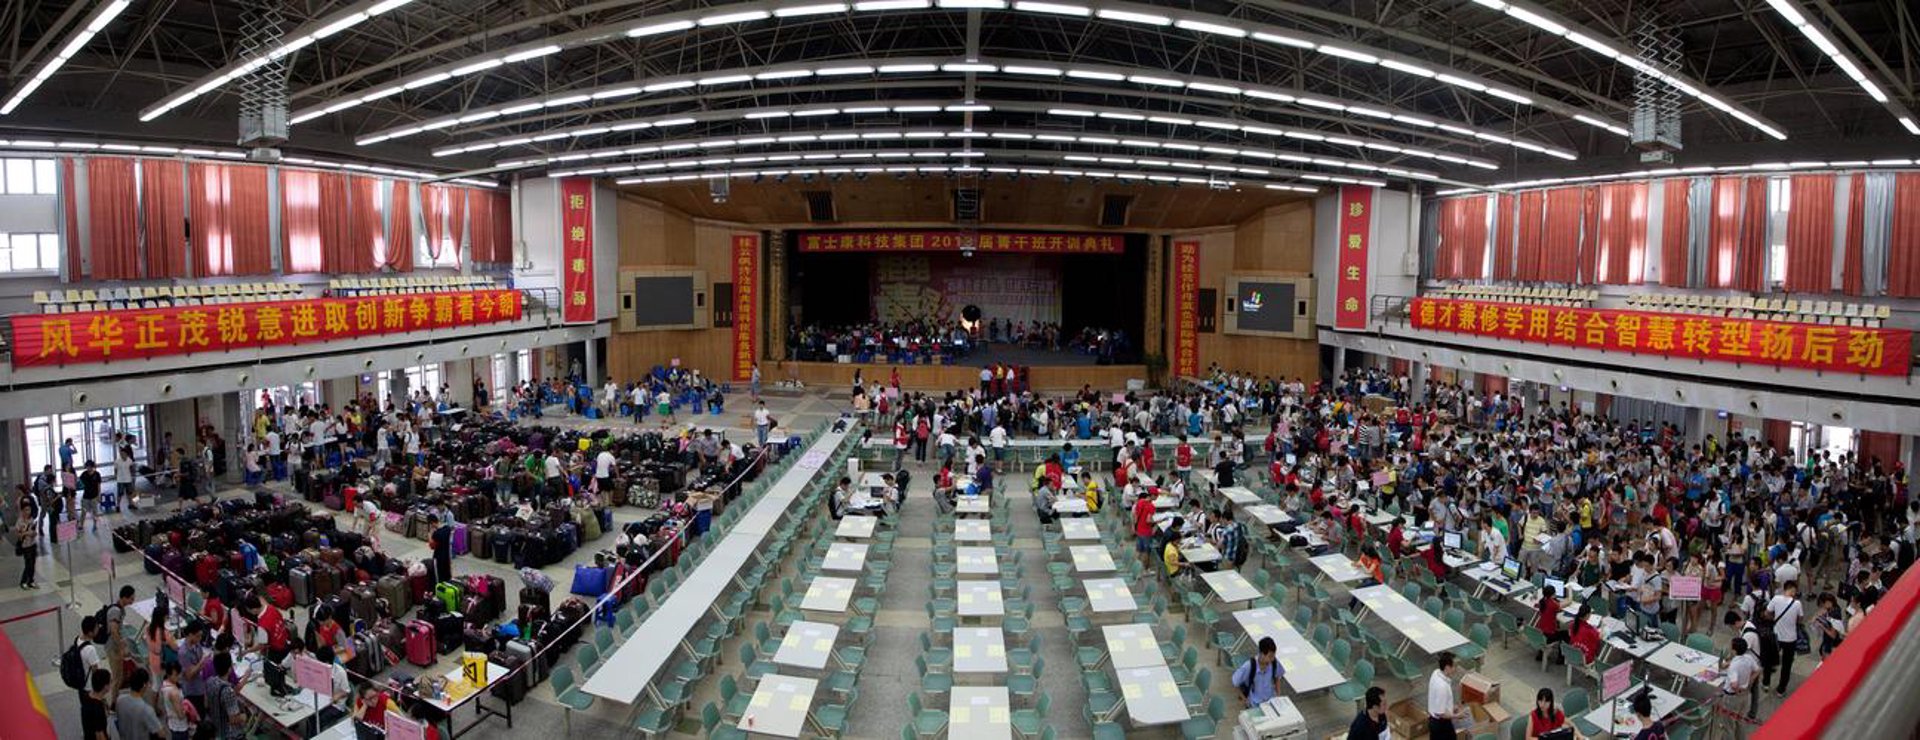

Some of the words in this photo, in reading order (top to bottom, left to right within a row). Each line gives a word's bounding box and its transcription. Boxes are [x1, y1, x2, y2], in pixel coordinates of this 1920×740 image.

[571, 195, 587, 306] 拒绝毒品
[1345, 203, 1364, 312] 珍爱生命
[39, 291, 516, 358] 风华正茂锐意进取创新争霸看今朝
[1420, 300, 1885, 369] 德才兼修学用结合智慧转型扬后劲
